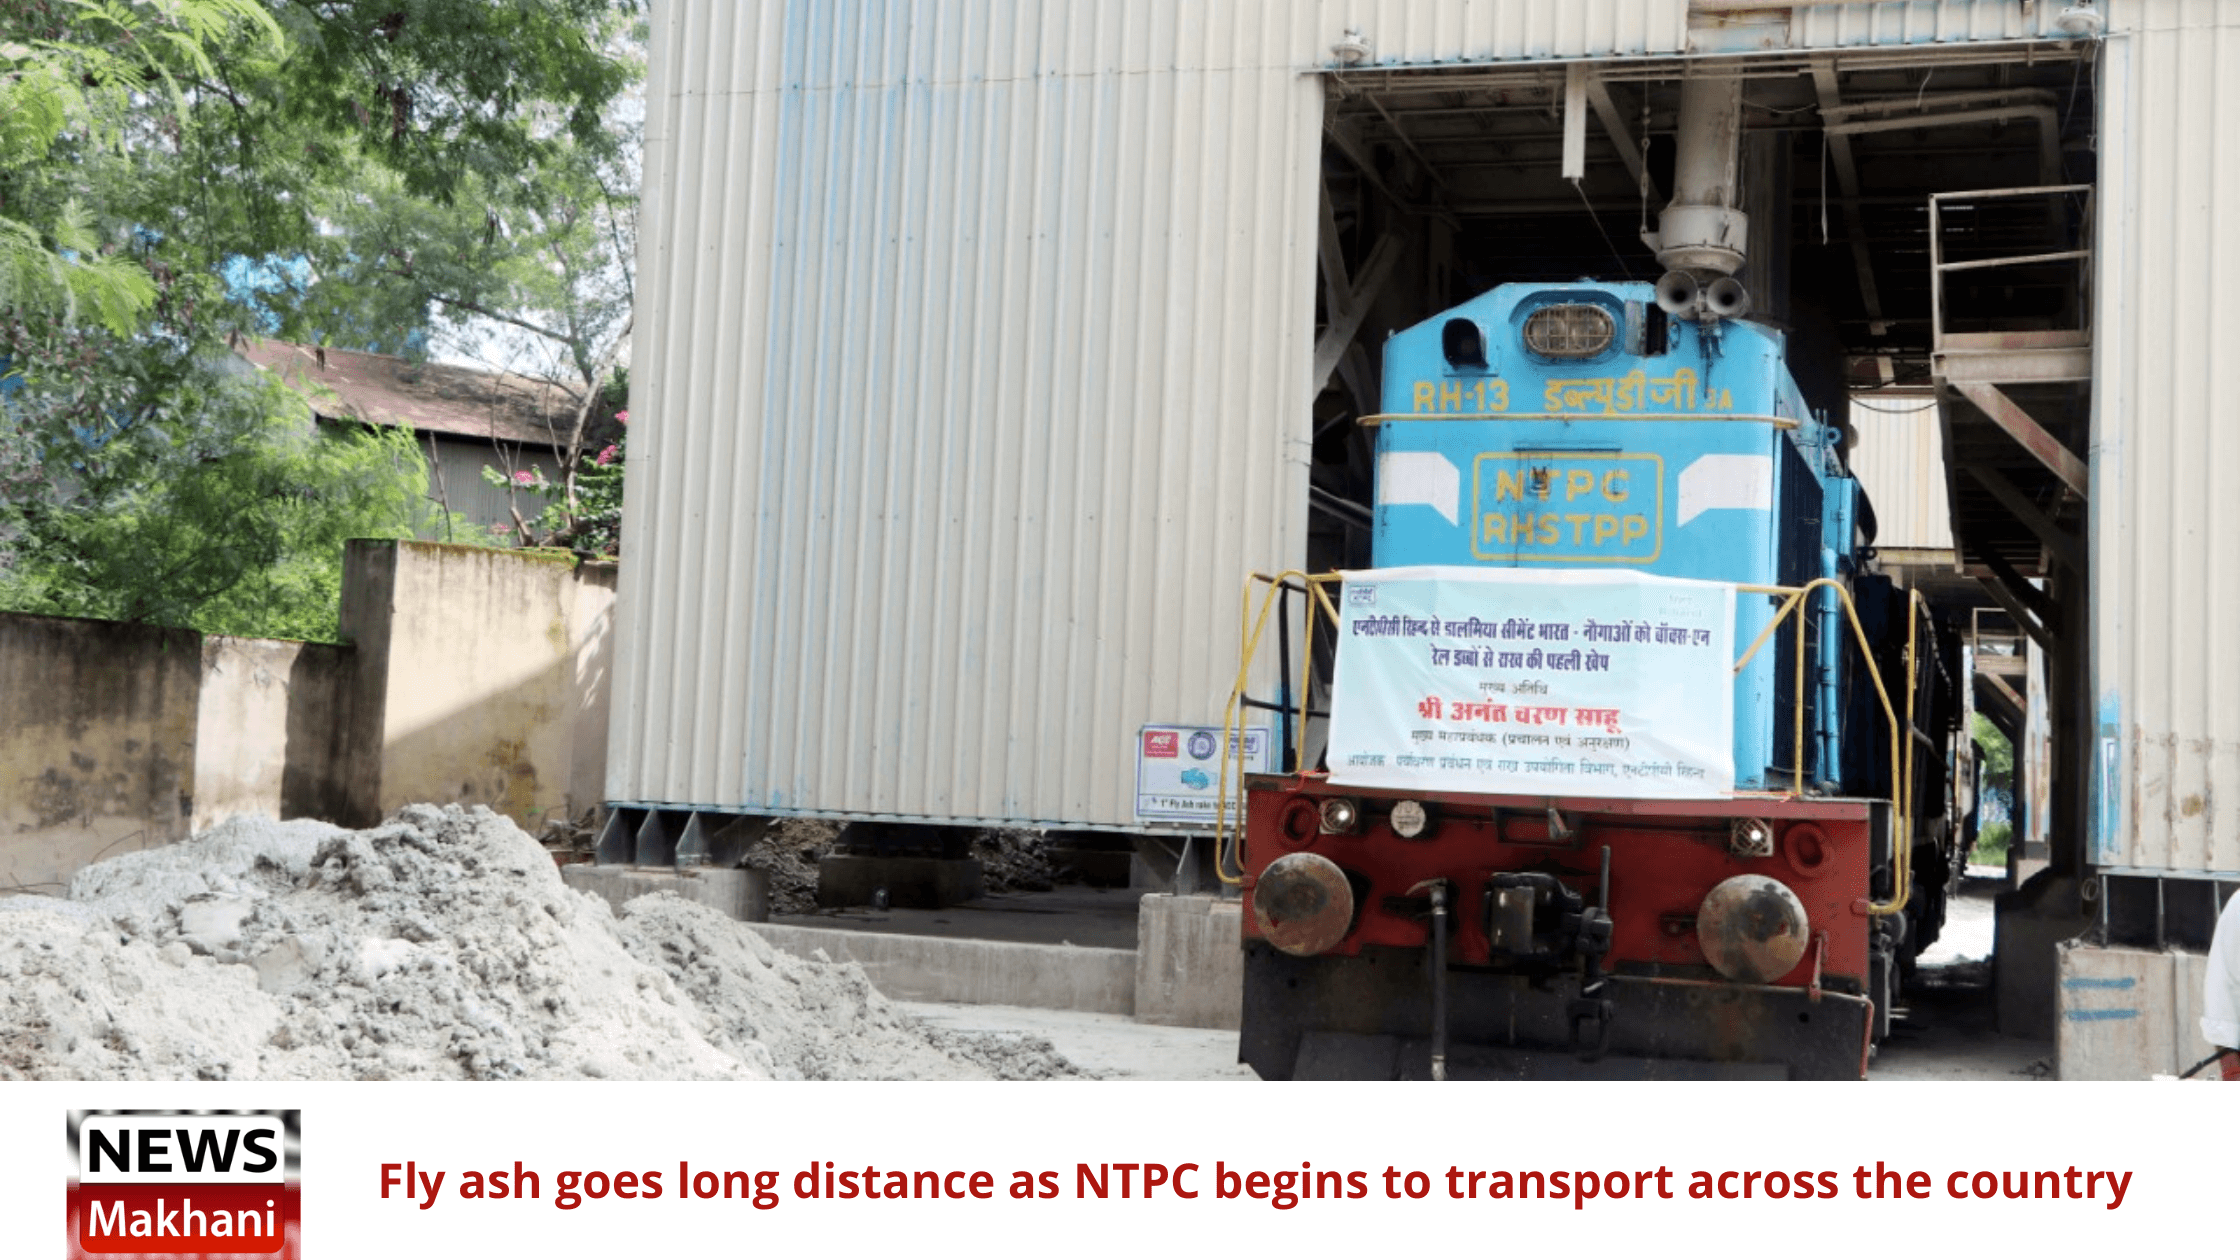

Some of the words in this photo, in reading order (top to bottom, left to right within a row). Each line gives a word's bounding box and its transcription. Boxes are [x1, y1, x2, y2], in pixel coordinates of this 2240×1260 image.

[1413, 381, 1510, 412] RH-13
[1496, 469, 1631, 502] NTPC
[1483, 513, 1649, 546] RHSTPP
[1539, 623, 1570, 641] भारत
[1634, 620, 1651, 644] को
[1483, 645, 1494, 668] से
[1526, 648, 1543, 670] की
[1547, 649, 1581, 671] पहली
[1418, 695, 1442, 720] श्री
[1451, 697, 1508, 723] अनंत
[1574, 708, 1622, 734] साहू
